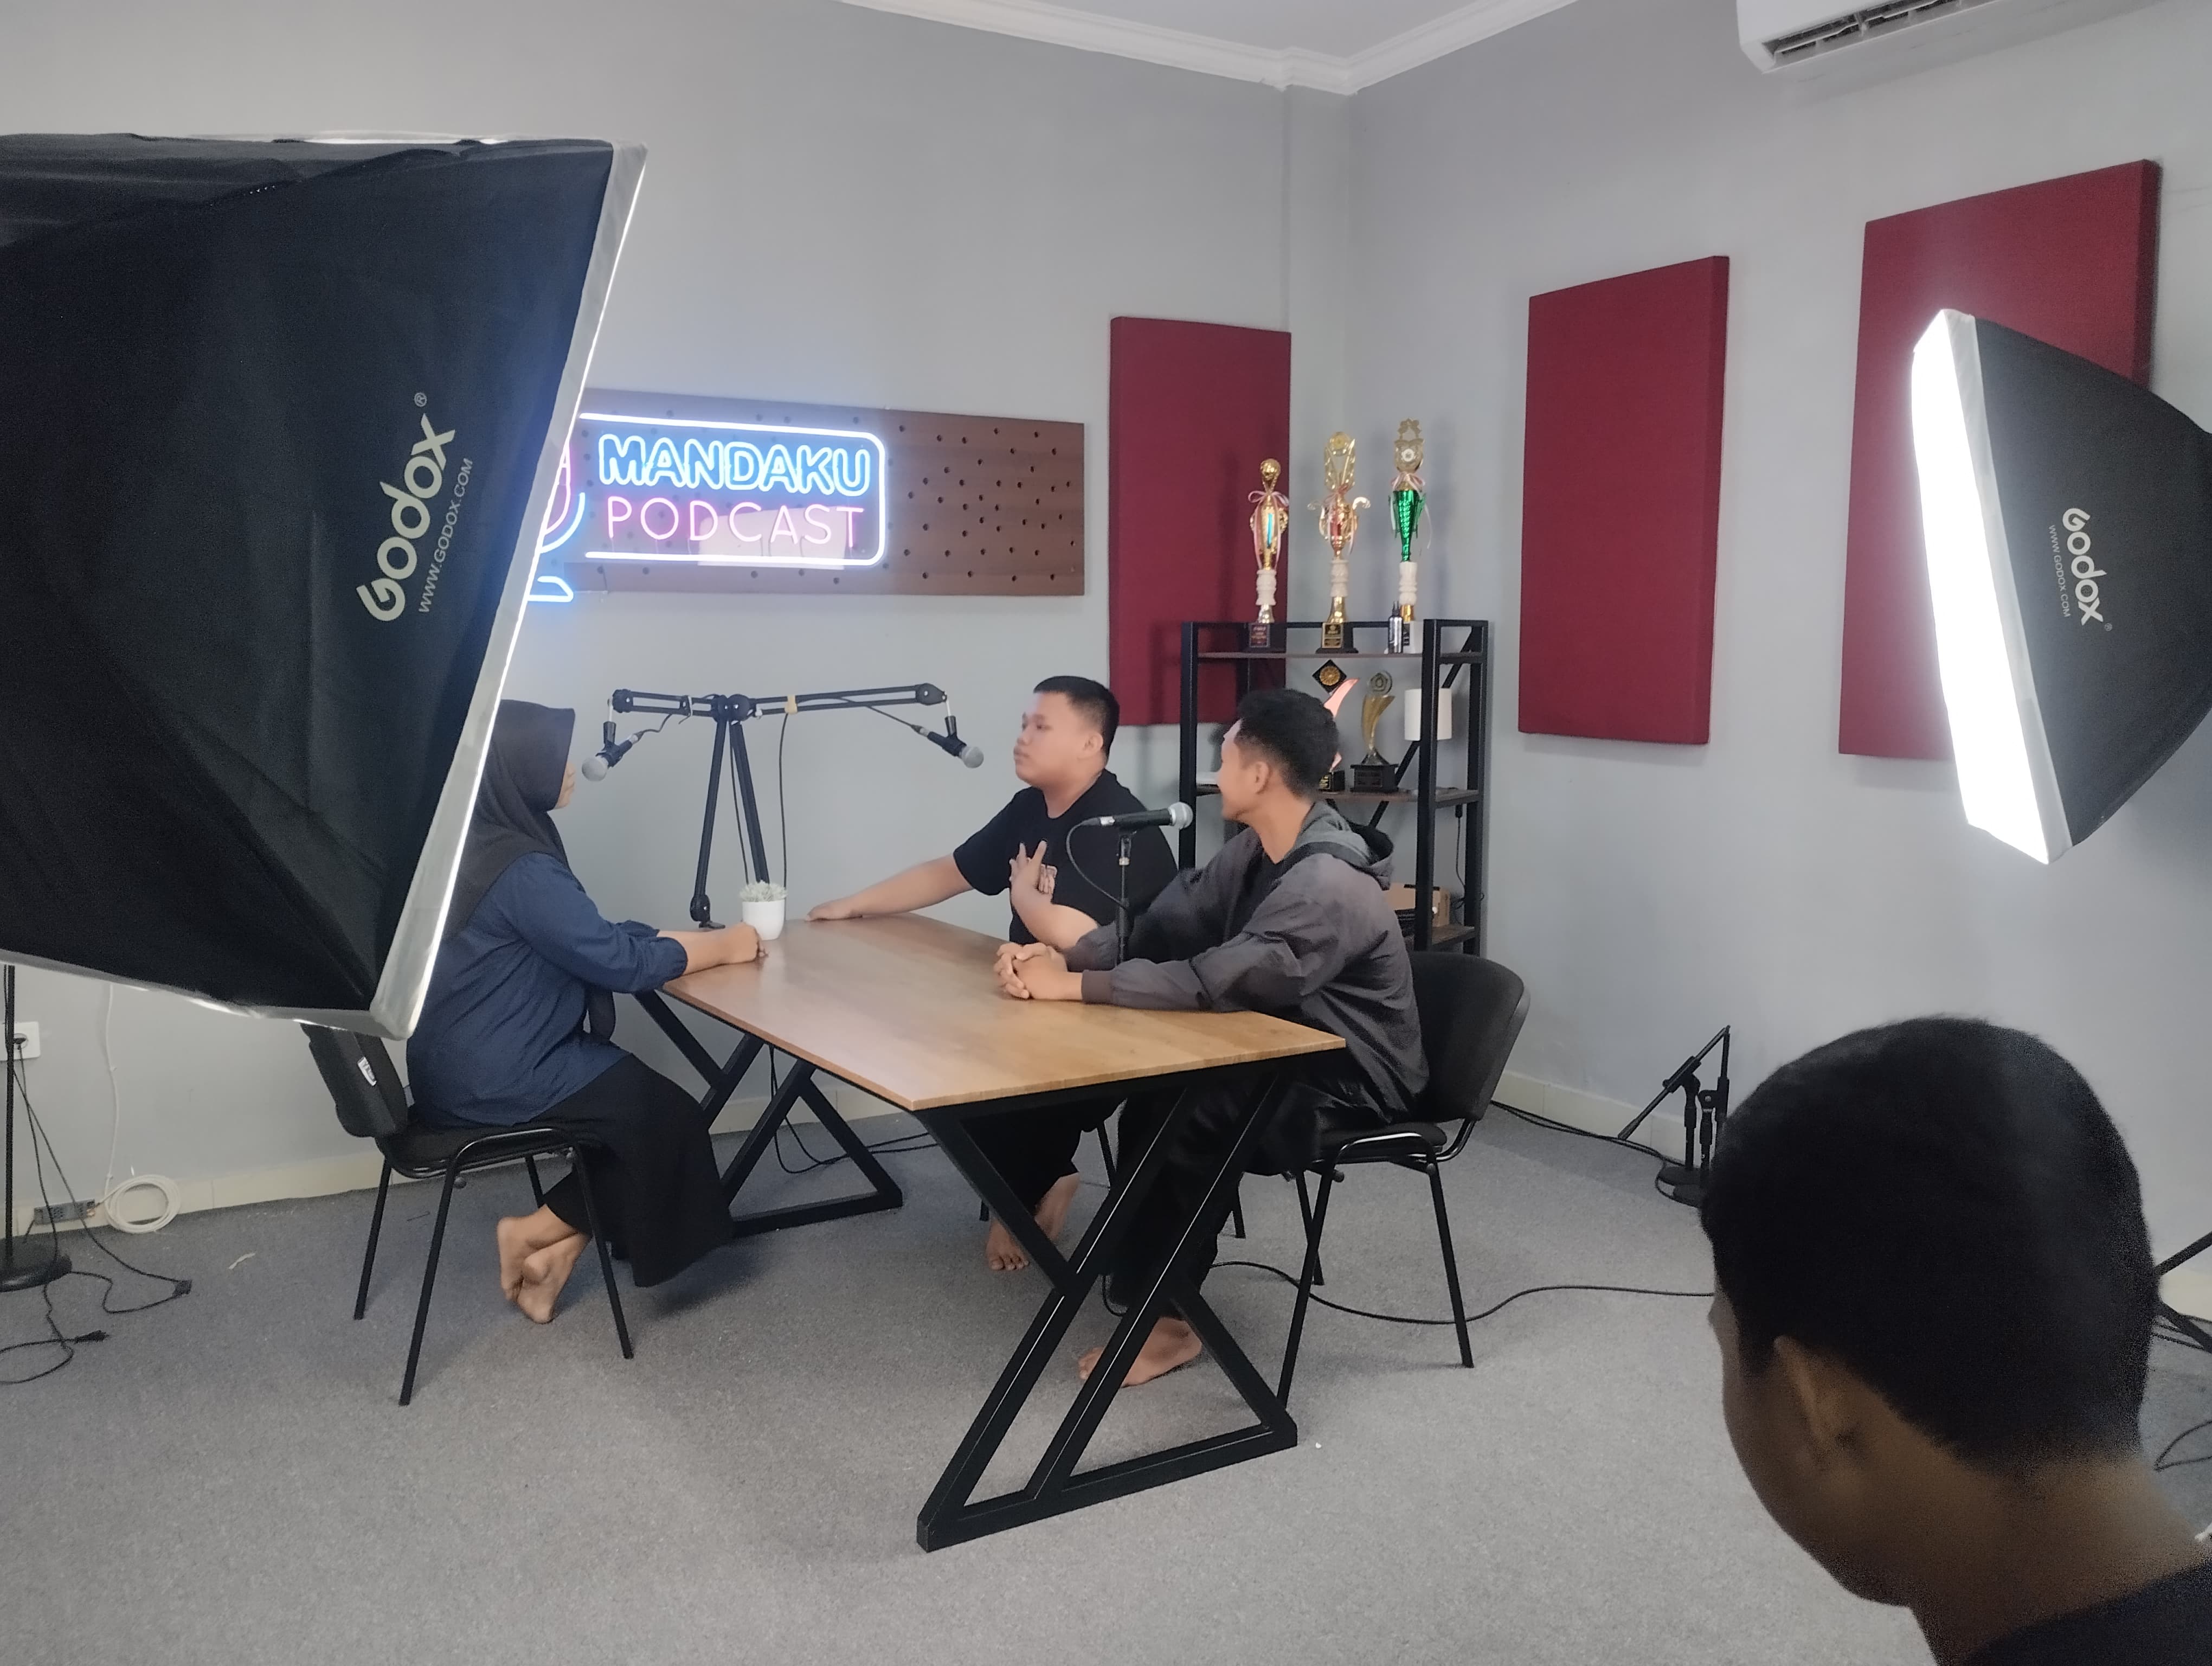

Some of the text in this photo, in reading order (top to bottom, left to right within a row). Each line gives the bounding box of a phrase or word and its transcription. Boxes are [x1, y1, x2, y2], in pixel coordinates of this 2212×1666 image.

[599, 434, 870, 496] MANDAKU
[419, 458, 473, 613] WWW.GODOX.COM
[608, 496, 864, 548] PODCAST
[2049, 524, 2070, 617] WWWGODOXCOM
